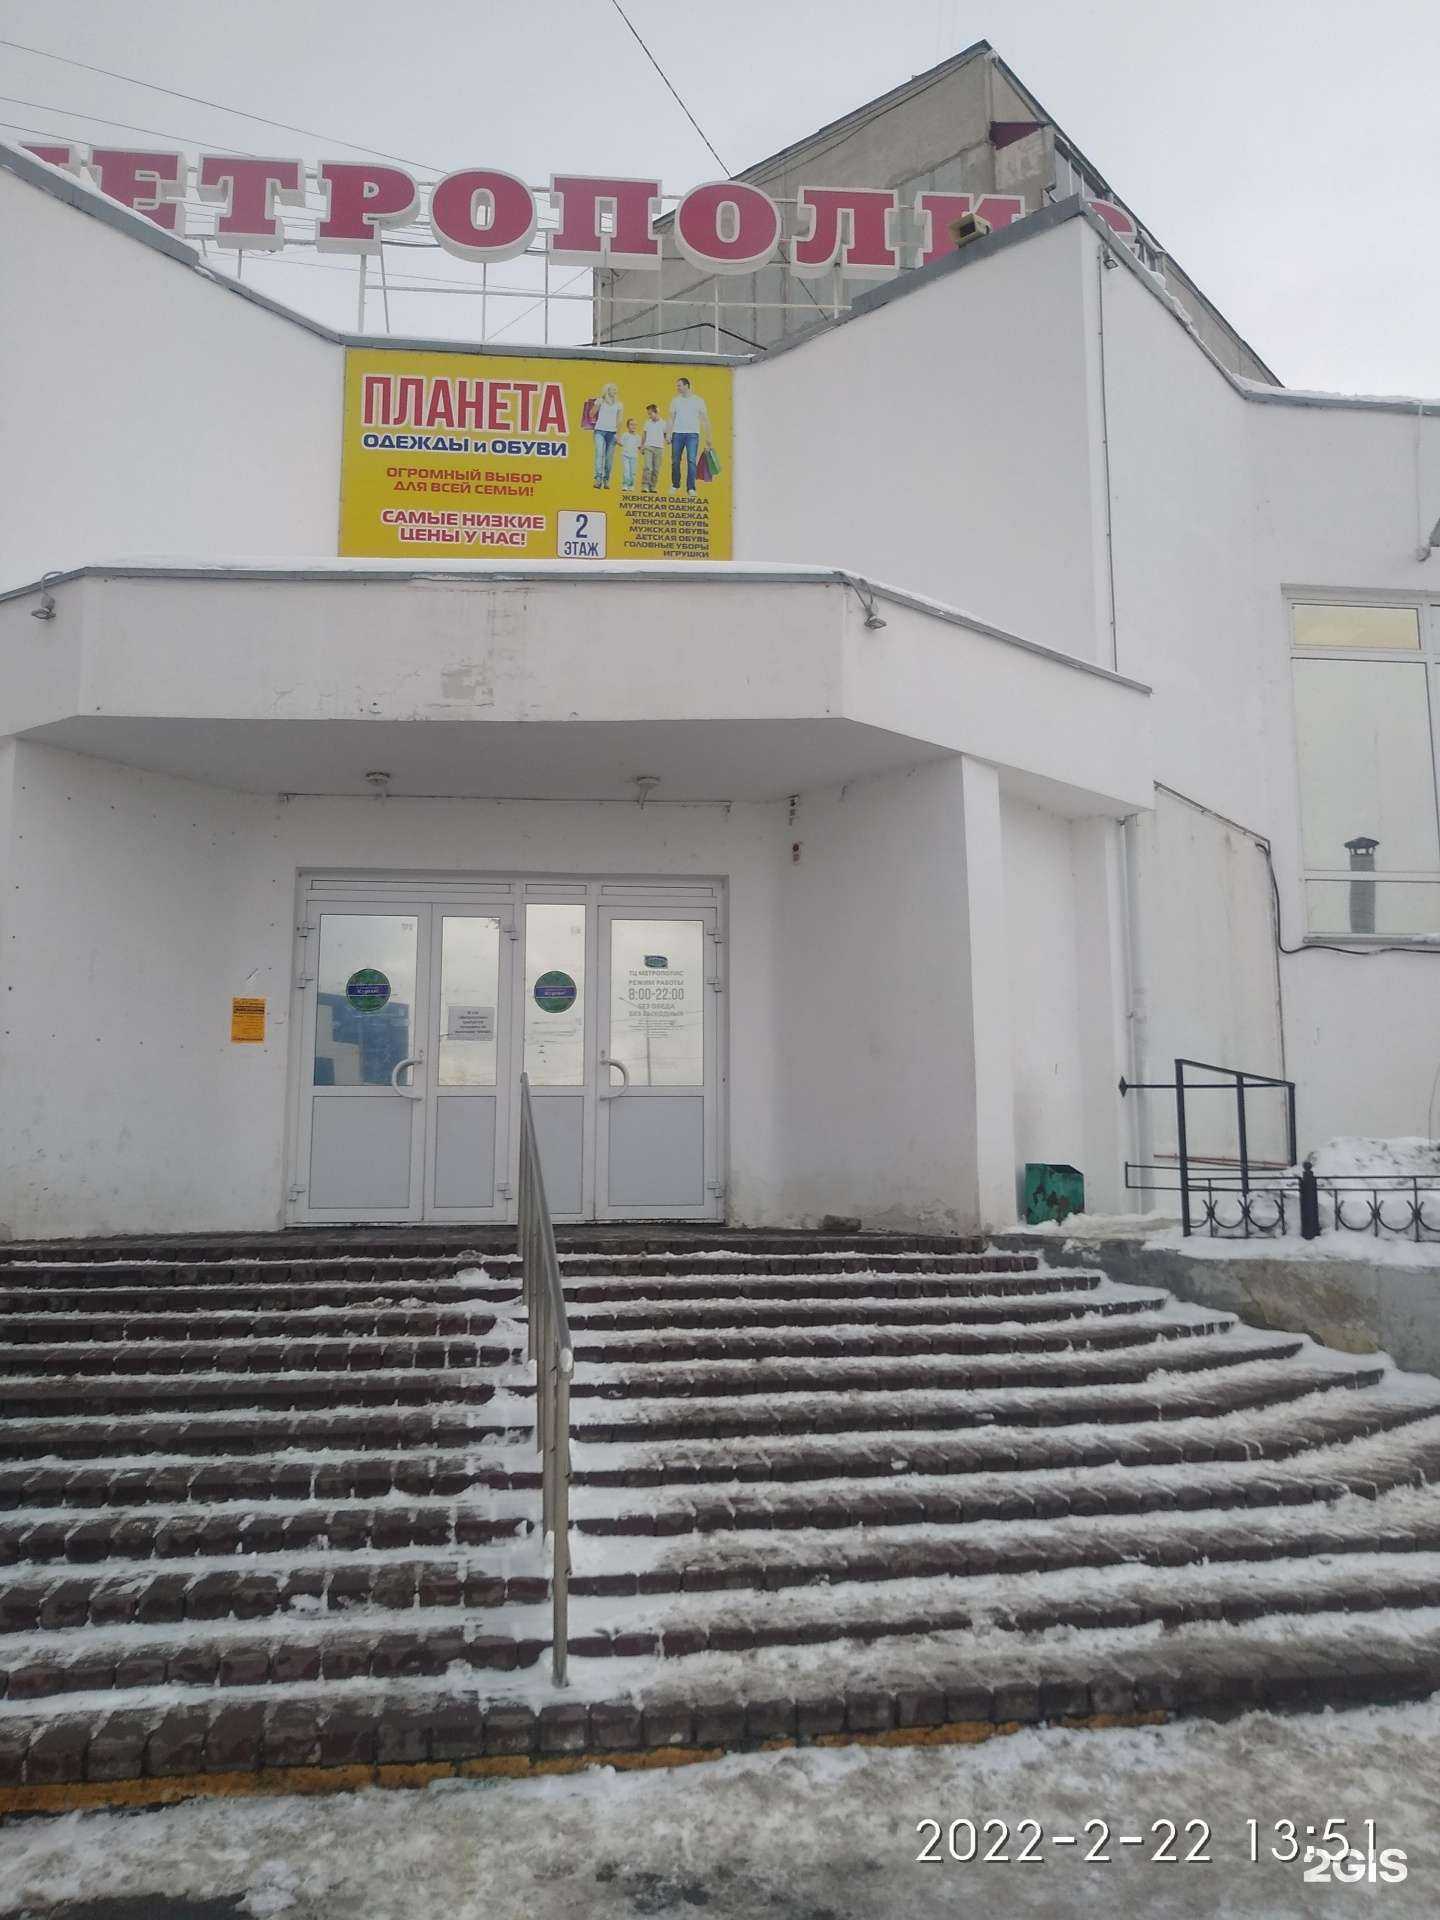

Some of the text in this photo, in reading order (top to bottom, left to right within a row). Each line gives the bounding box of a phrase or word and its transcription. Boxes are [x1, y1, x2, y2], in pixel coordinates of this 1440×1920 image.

[363, 376, 567, 433] ПЛАНЕТА
[363, 434, 567, 456] ОДЕЖДЫ и ОБУВИ
[386, 467, 542, 483] ОГРОМНЫЙ ВЫБОР
[393, 482, 534, 496] ДЛЯ ВСЕЙ СЕМЬИ!
[622, 495, 709, 504] ЖЕНСКАЯ ОДЕЖДА
[619, 502, 709, 512] МУЖСКАЯ ОДЕЖДА
[382, 510, 545, 530] САМЫЕ НИЗКИЕ
[625, 510, 709, 519] ДЕТСКАЯ ОДЕЖДА
[575, 514, 589, 539] 2
[632, 518, 677, 526] ЖЕНСКАЯ
[400, 528, 526, 545] ЦЕНЫ У НАС!
[629, 526, 709, 535] МУЖСКАЯ ОБУВЬ
[624, 541, 709, 550] ГОЛОВНЫЕ УБОРЫ
[678, 535, 709, 543] ОБУВЬ
[563, 541, 599, 557] ЭТАЖ
[663, 550, 709, 558] ИГРУШКИ
[628, 988, 684, 1001] 8:00-22:00
